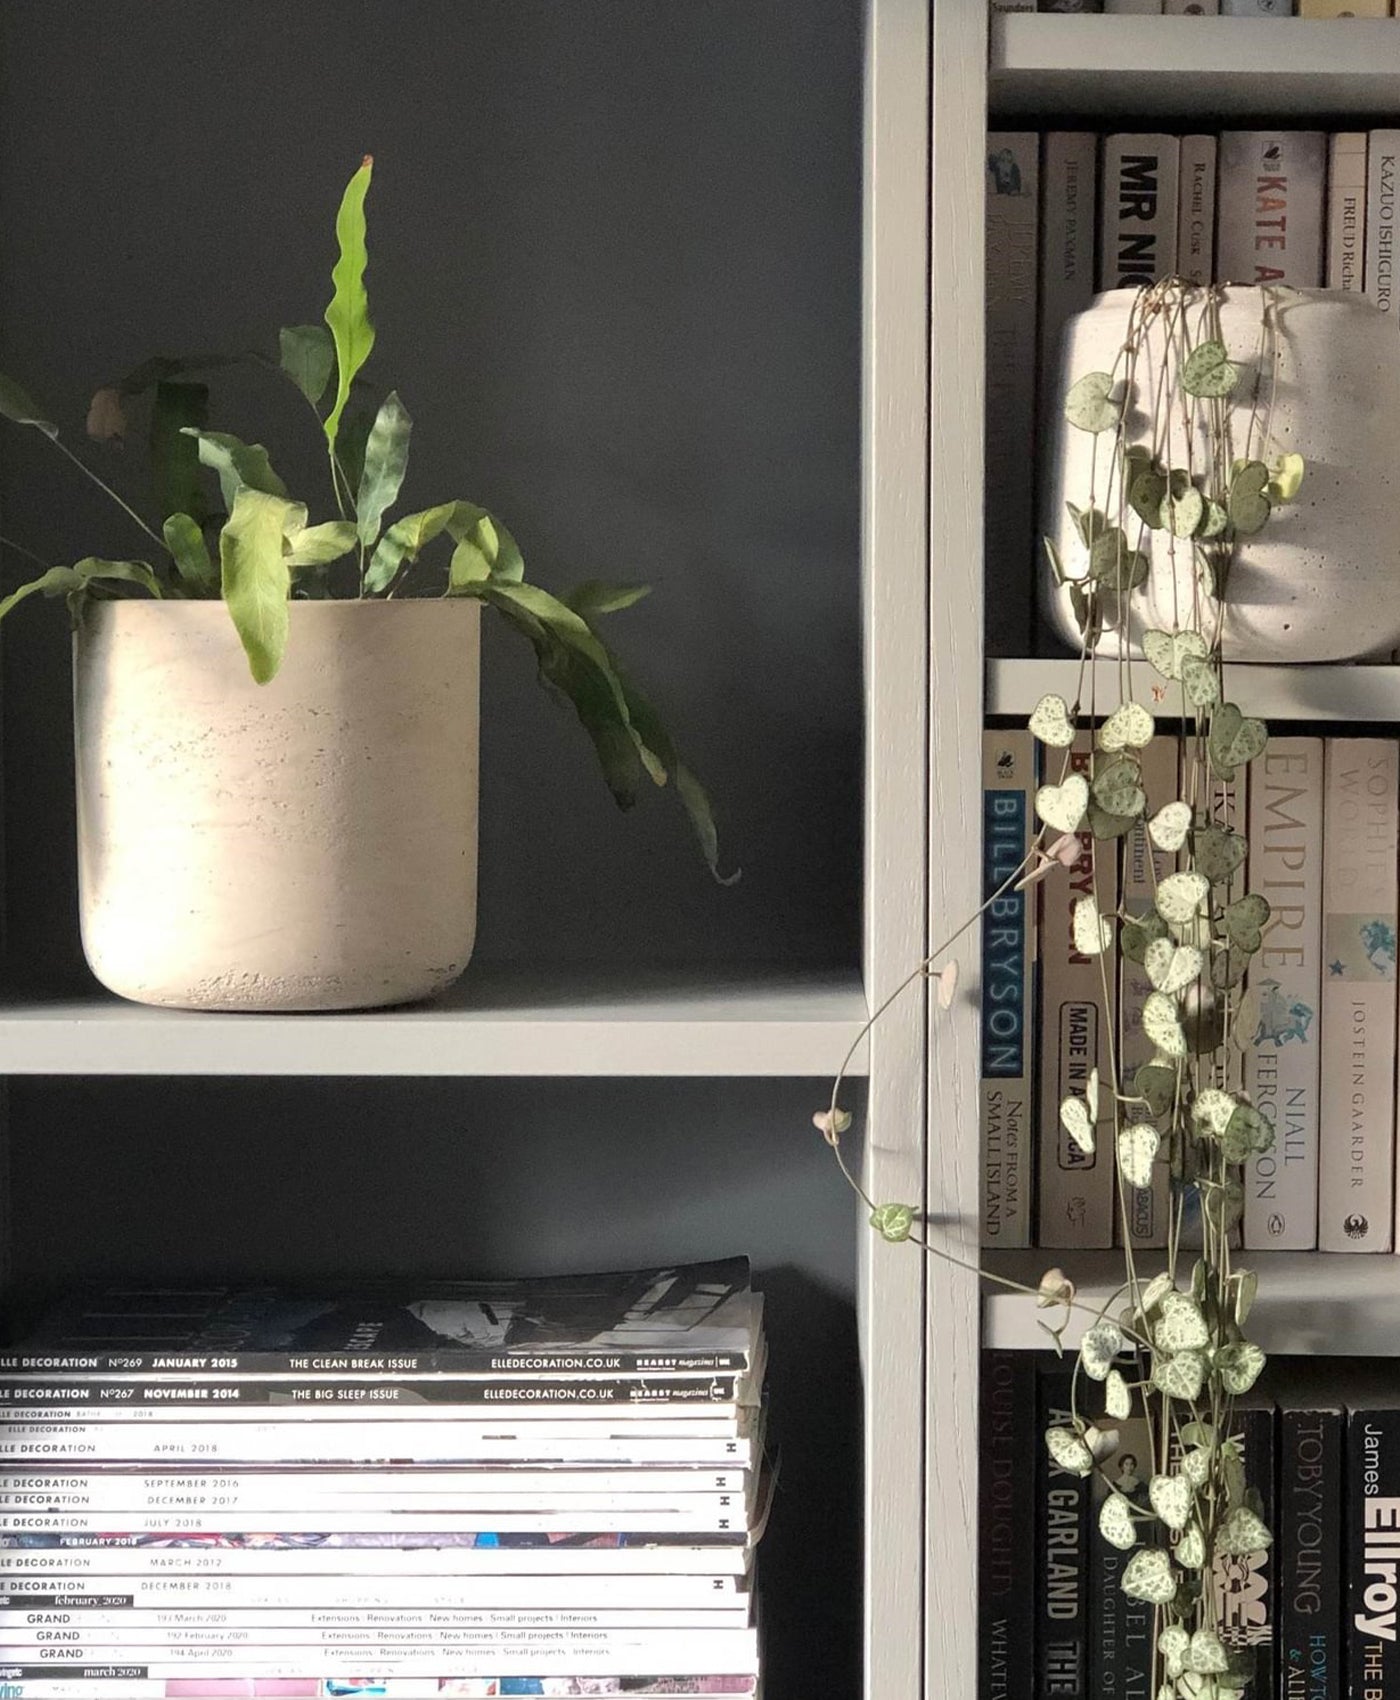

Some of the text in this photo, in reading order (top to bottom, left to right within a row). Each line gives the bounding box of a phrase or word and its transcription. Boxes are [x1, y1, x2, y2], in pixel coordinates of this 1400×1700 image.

[1064, 159, 1079, 213] JEREMY
[1119, 154, 1159, 221] MR
[1191, 162, 1207, 215] RACHEL
[1255, 176, 1288, 251] KATE
[1343, 197, 1357, 249] FREUD
[1376, 155, 1396, 313] KAZUO ISHIGURO
[1190, 220, 1204, 256] CUSK
[992, 799, 1018, 882] BILL
[1261, 751, 1309, 969] EMPIRE
[988, 896, 1020, 1070] BRYSON
[1068, 1007, 1089, 1055] MADE
[1068, 1062, 1088, 1080] IN
[1350, 1002, 1367, 1189] JOSTEIN GAARDER
[1283, 1087, 1307, 1167] NIALL
[985, 1090, 1004, 1236] SMALL ISLAND
[1004, 1099, 1023, 1218] Notes FROM A
[22, 1358, 98, 1368] DECORATION
[152, 1358, 206, 1368] JANUARY
[211, 1358, 238, 1368] 2015
[289, 1359, 309, 1369] THE
[312, 1359, 348, 1369] CLEAN
[351, 1359, 384, 1369] BREAK
[388, 1359, 417, 1369] ISSUE
[491, 1358, 620, 1369] ELLEDECORATION.CO.UK
[14, 1389, 90, 1399] DECORATION
[143, 1388, 209, 1399] NOVEMBER
[211, 1388, 240, 1399] 2014
[291, 1389, 311, 1400] THE
[314, 1389, 334, 1400] BIG
[337, 1389, 366, 1400] SLEEP
[369, 1389, 399, 1399] ISSUE
[483, 1388, 613, 1399] ELLEDECORATION.CO.UK
[14, 1410, 71, 1419] DECORATION
[20, 1444, 96, 1453] DECORATION
[153, 1444, 185, 1452] APRIL
[191, 1444, 218, 1453] 2018
[1364, 1424, 1384, 1495] James
[13, 1479, 89, 1488] DECORATION
[144, 1479, 207, 1488] SEPTEMBER
[212, 1479, 239, 1488] 2016
[14, 1495, 90, 1504] DECORATION
[147, 1496, 206, 1505] DECEMBER
[211, 1496, 239, 1505] 2017
[13, 1518, 89, 1527] DECORATION
[145, 1518, 170, 1528] JULY
[175, 1518, 203, 1528] 2018
[59, 1537, 112, 1546] FEBRUARY
[1293, 1426, 1324, 1614] TOBY YOUNG
[16, 1558, 91, 1568] DECORATION
[150, 1558, 192, 1567] MARCH
[1046, 1490, 1079, 1620] GARLAND
[1355, 1497, 1400, 1642] Ellroy
[10, 1582, 86, 1591] DECORATION
[141, 1581, 200, 1591] DECEMBER
[205, 1581, 232, 1591] 2018
[54, 1594, 128, 1607] february 2020
[27, 1613, 71, 1624] GRAND
[311, 1614, 360, 1623] Extensions
[367, 1614, 423, 1623] Renovations
[429, 1614, 450, 1623] New
[454, 1614, 483, 1623] homes
[490, 1614, 516, 1623] Small
[517, 1614, 554, 1625] projects
[560, 1614, 598, 1623] Interiors
[36, 1631, 81, 1641] GRAND
[321, 1631, 370, 1640] Extensions
[377, 1631, 433, 1640] Renovations
[440, 1631, 461, 1640] New
[464, 1631, 493, 1640] homes
[500, 1631, 527, 1640] Small
[529, 1631, 564, 1642] projects
[570, 1631, 608, 1640] Interiors
[1102, 1556, 1119, 1696] DAUGHTER OF
[40, 1648, 84, 1659] GRAND
[324, 1648, 373, 1657] Extensions
[380, 1648, 435, 1657] Renovations
[443, 1648, 463, 1657] New
[466, 1648, 496, 1657] homes
[503, 1648, 530, 1657] Small
[531, 1648, 567, 1659] projects
[573, 1648, 611, 1657] Interiors
[84, 1666, 140, 1677] march 2020
[1045, 1640, 1080, 1696] THE
[1309, 1635, 1328, 1683] HOW
[1364, 1641, 1383, 1681] THE
